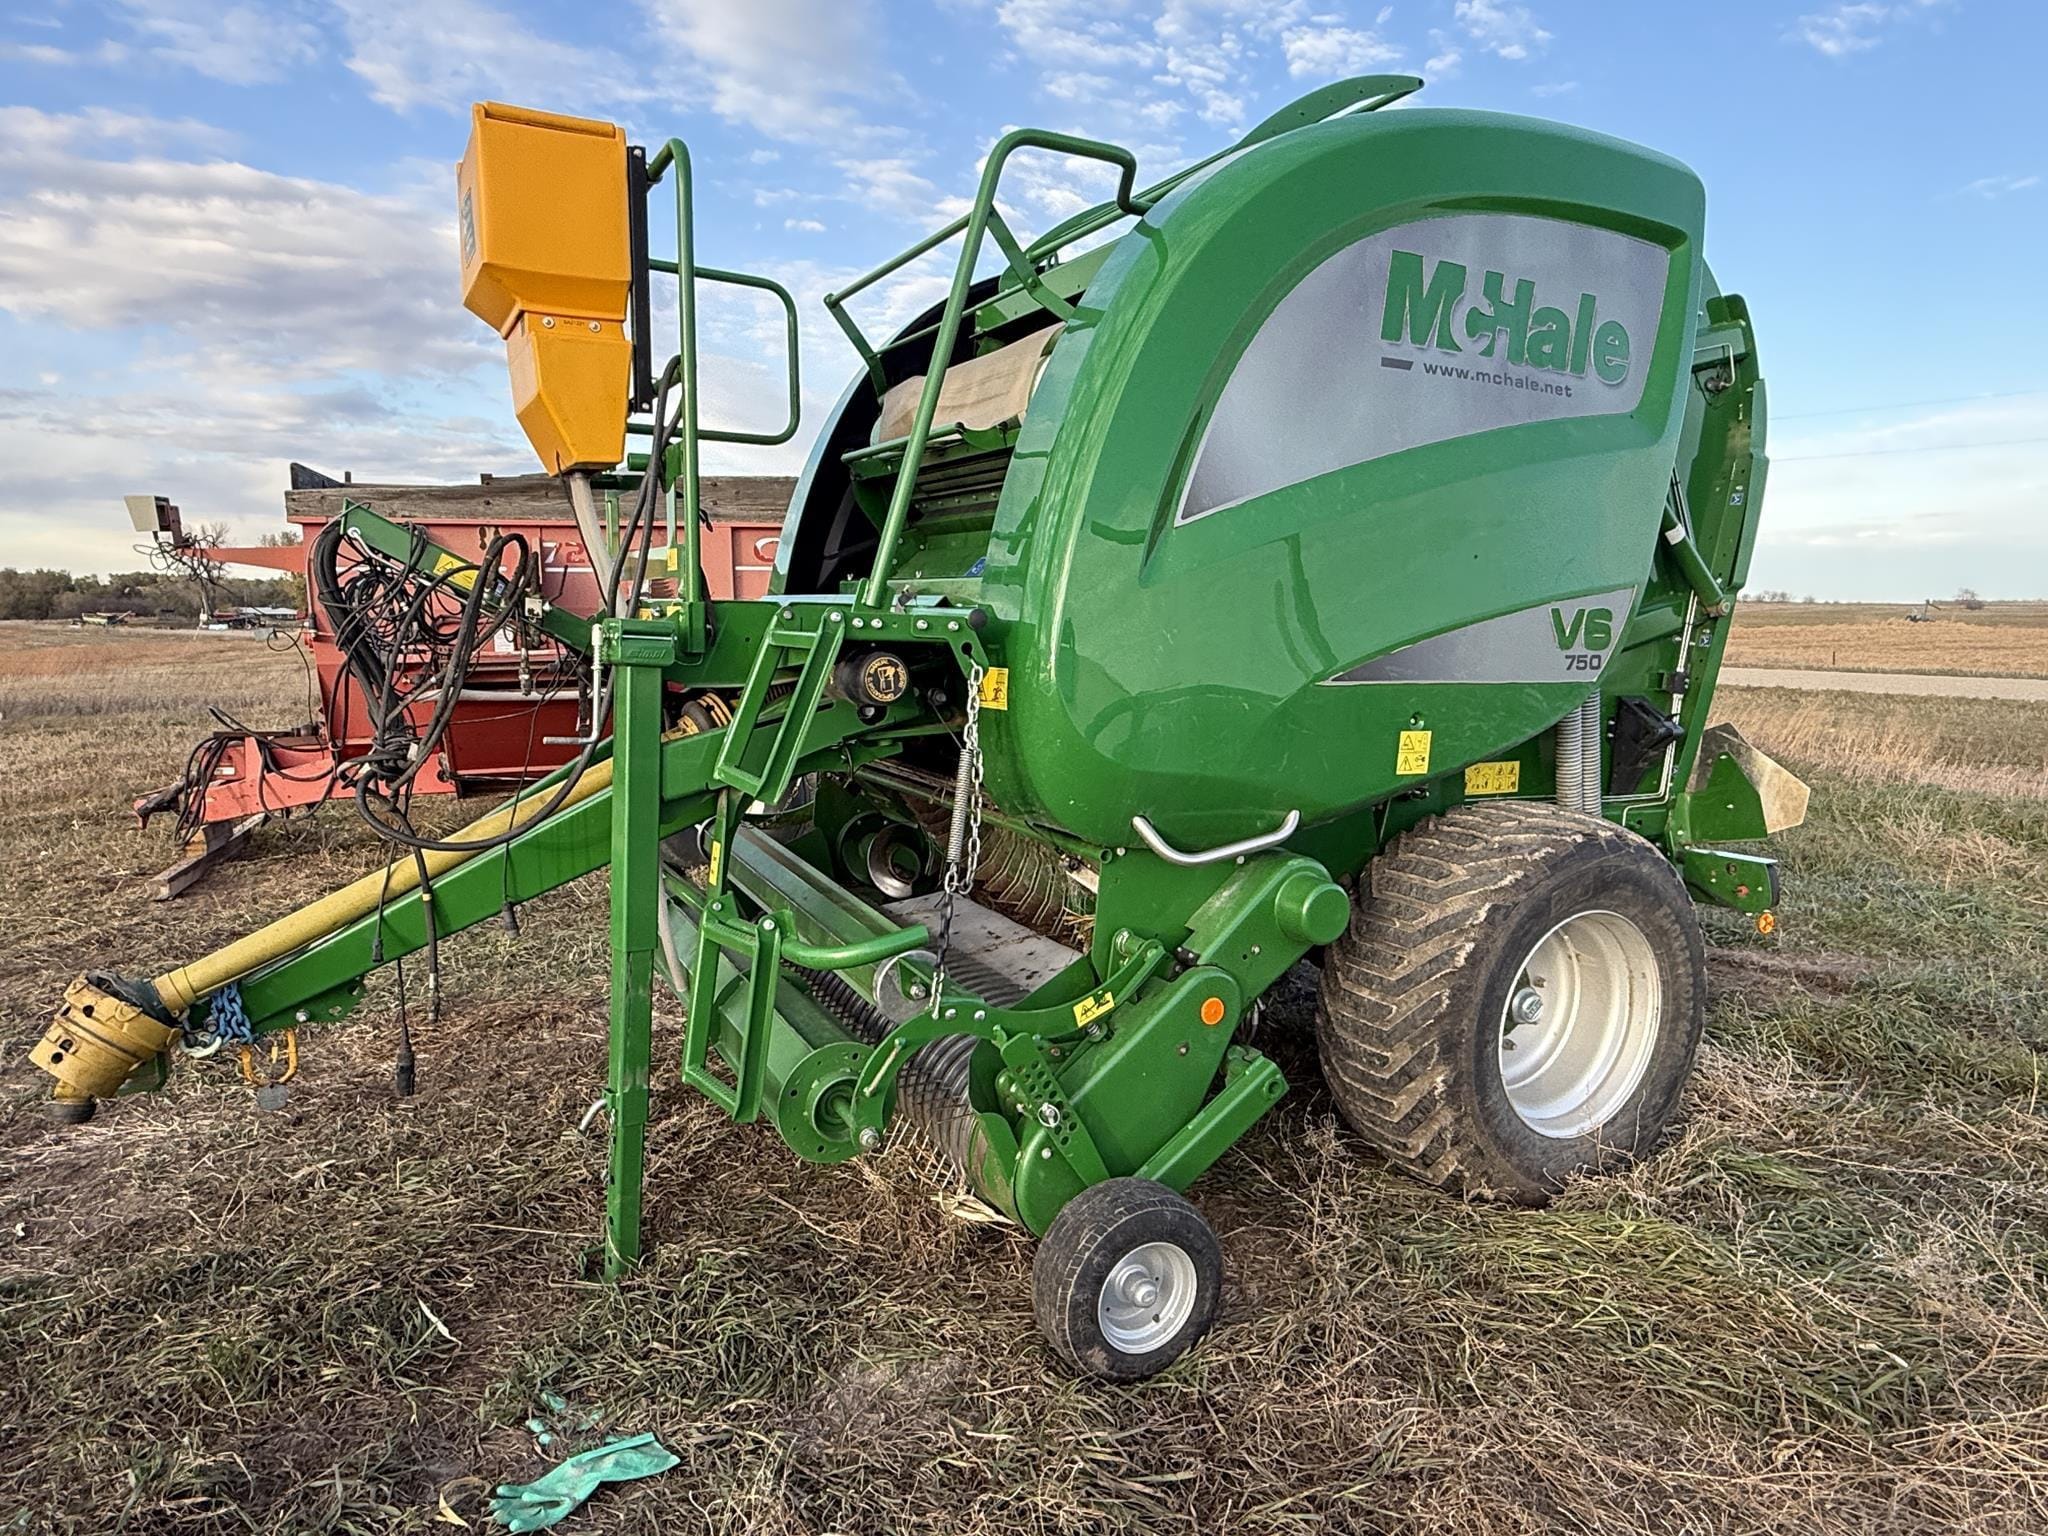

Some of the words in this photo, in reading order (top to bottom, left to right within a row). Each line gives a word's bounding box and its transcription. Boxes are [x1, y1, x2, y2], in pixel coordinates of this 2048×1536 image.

[1379, 249, 1631, 386] McHale
[1423, 361, 1573, 398] www.mchale.net
[1550, 607, 1613, 652] V6
[1564, 654, 1602, 671] 750
